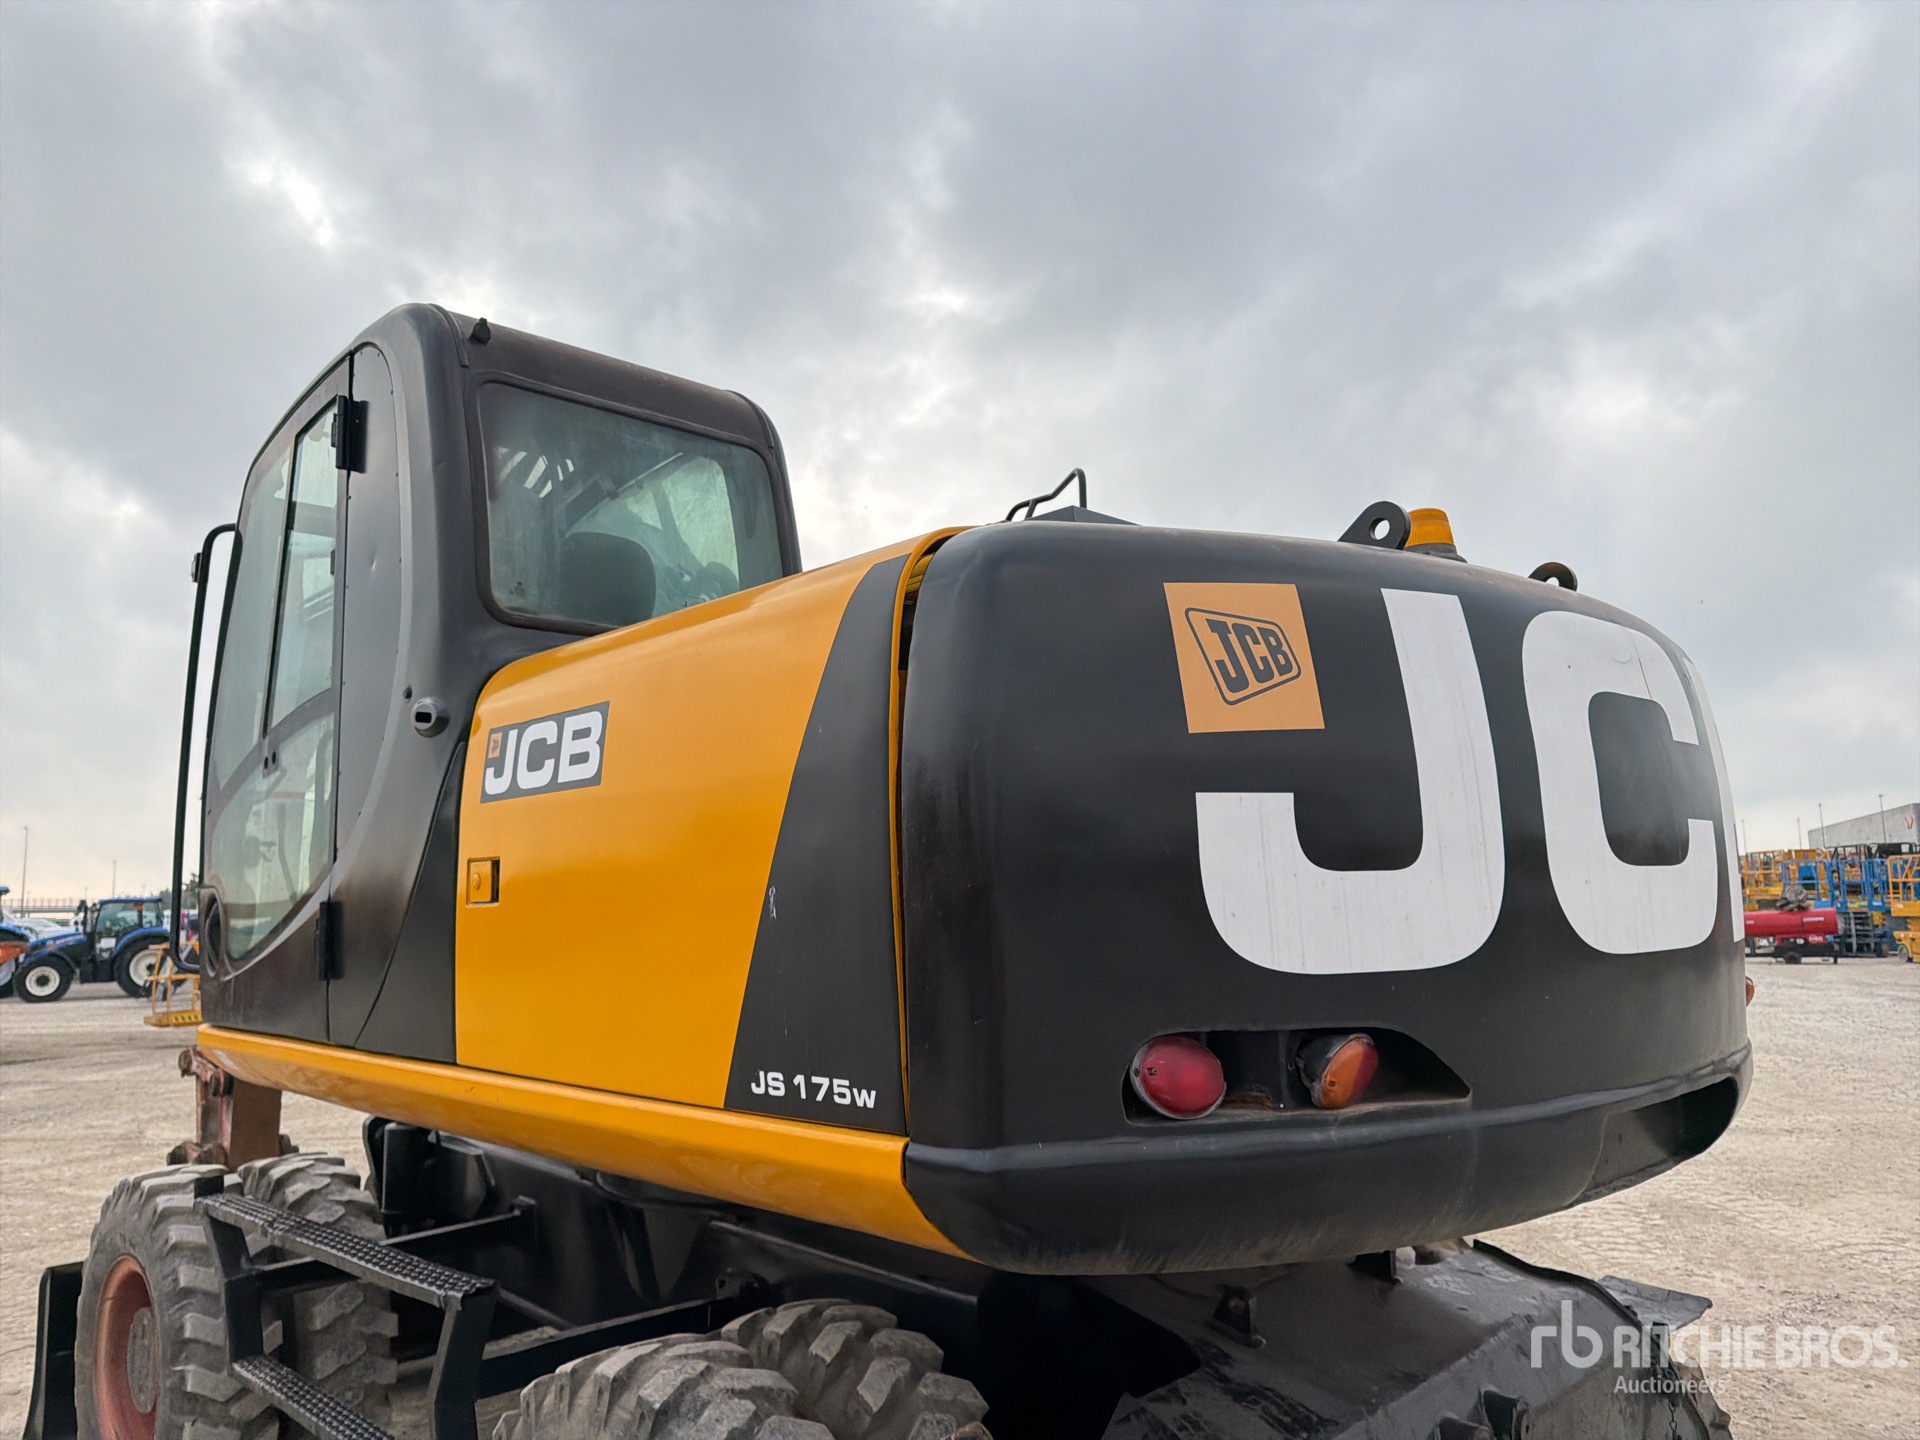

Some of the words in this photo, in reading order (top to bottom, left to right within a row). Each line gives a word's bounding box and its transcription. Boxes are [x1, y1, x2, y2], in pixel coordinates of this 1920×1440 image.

[1205, 617, 1294, 694] JCB
[484, 710, 603, 795] JCB
[1195, 587, 1745, 976] JC
[751, 1070, 785, 1097] JS
